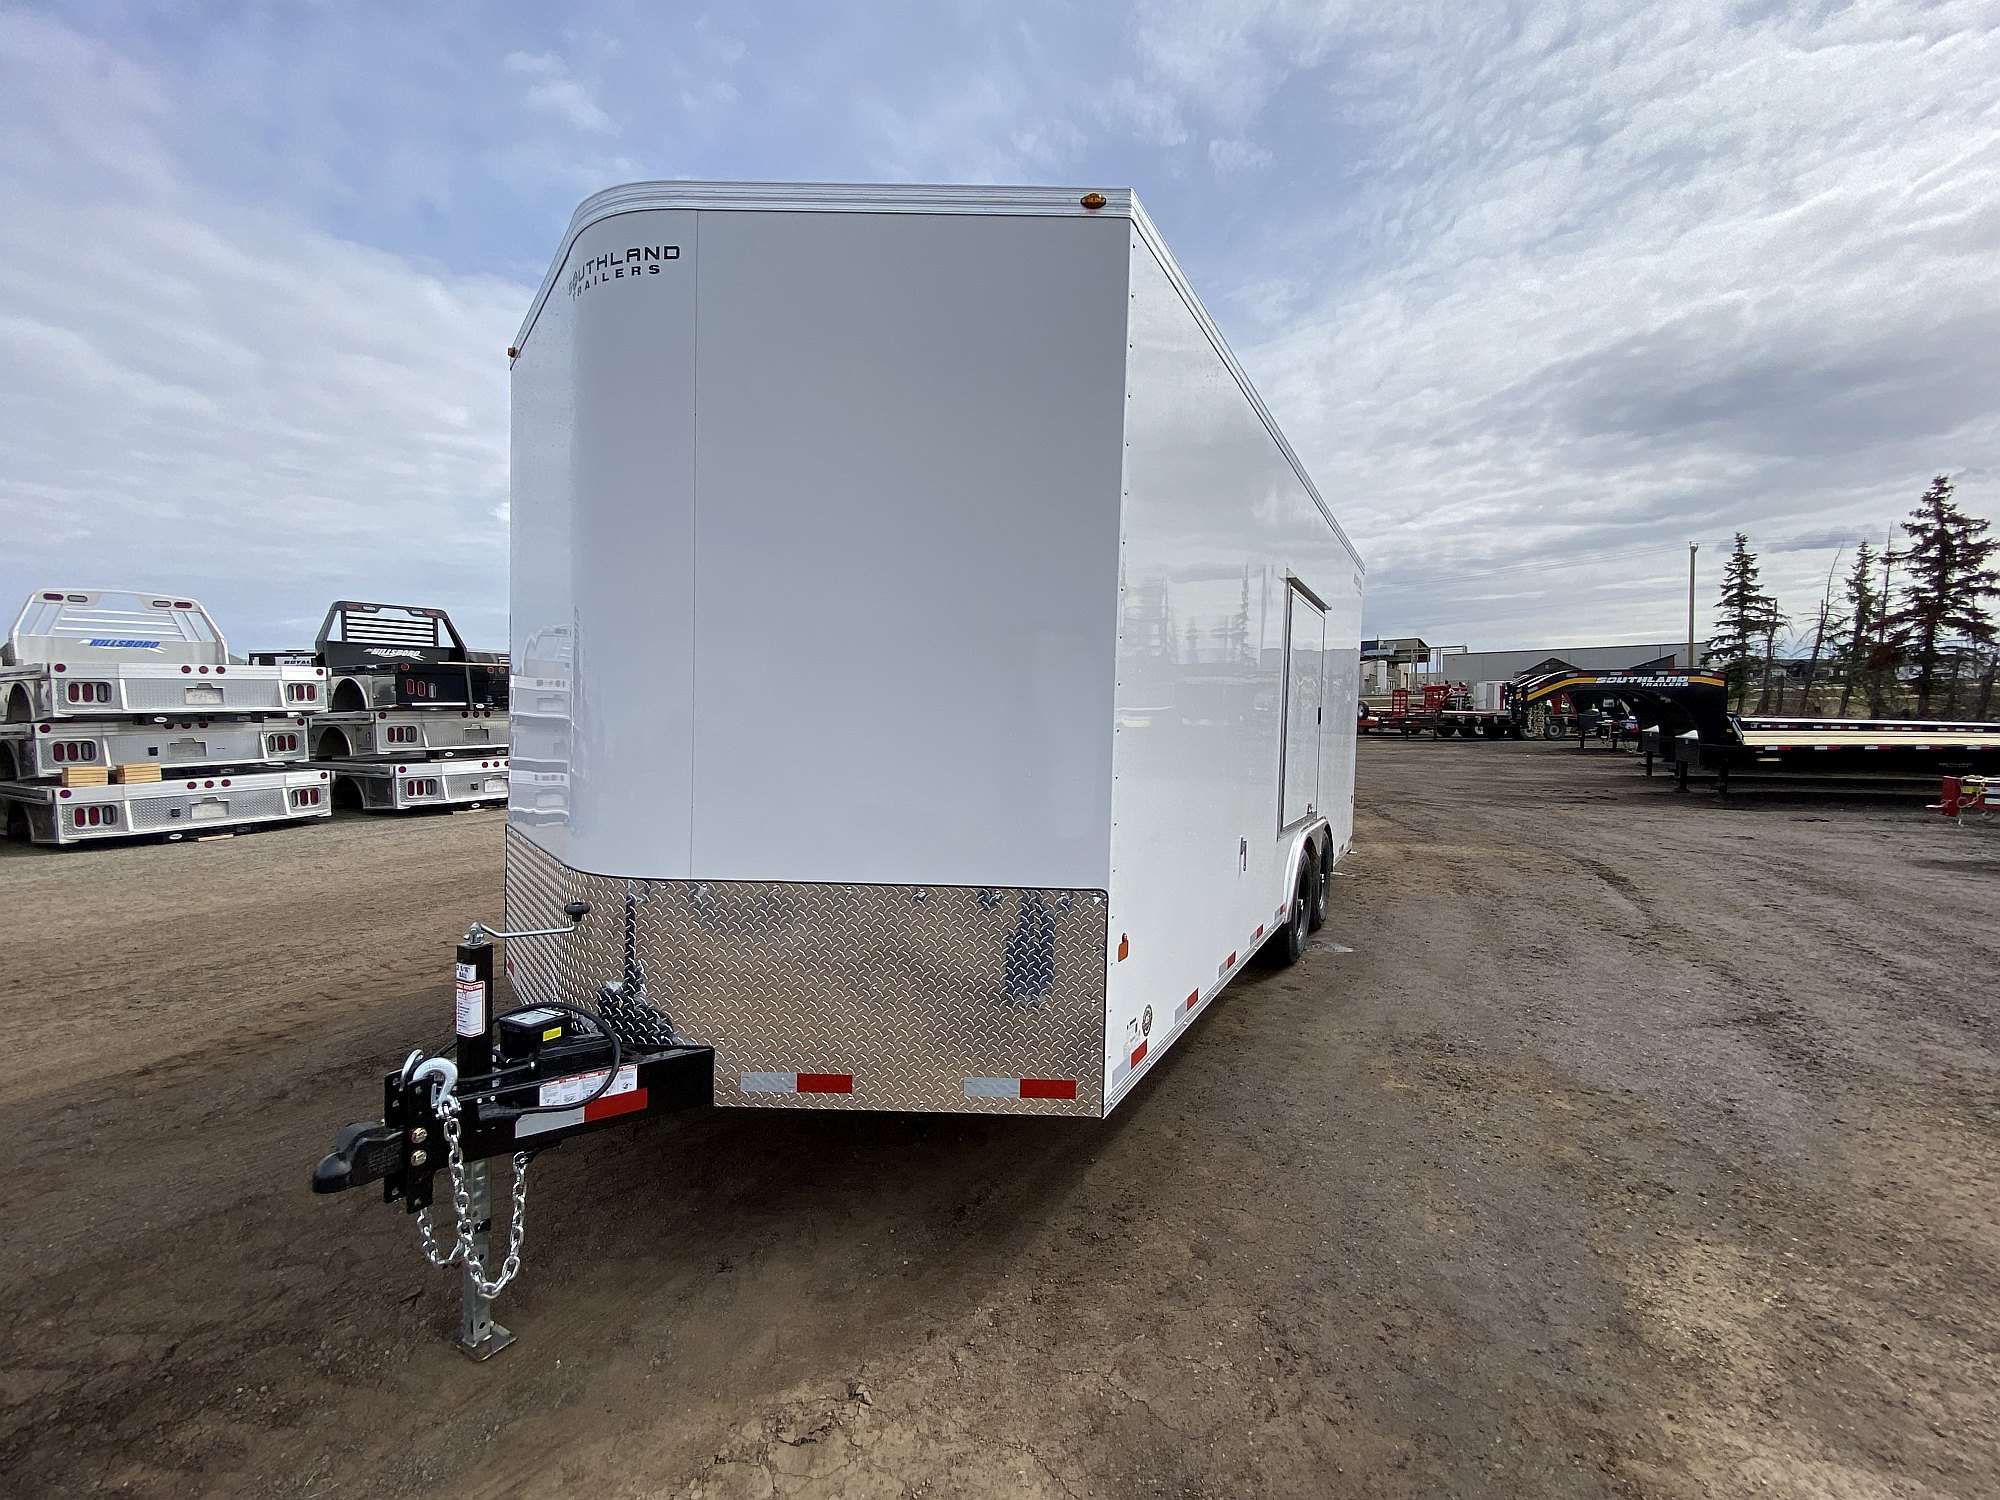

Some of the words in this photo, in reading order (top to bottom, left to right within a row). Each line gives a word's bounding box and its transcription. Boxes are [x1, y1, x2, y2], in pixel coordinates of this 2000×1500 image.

[568, 246, 680, 296] SOUTHLAND
[572, 265, 660, 301] TRAILERS
[90, 639, 160, 648] HILLSBORO
[371, 648, 421, 657] HILLSBORO
[1595, 676, 1688, 684] SOUTHLAND
